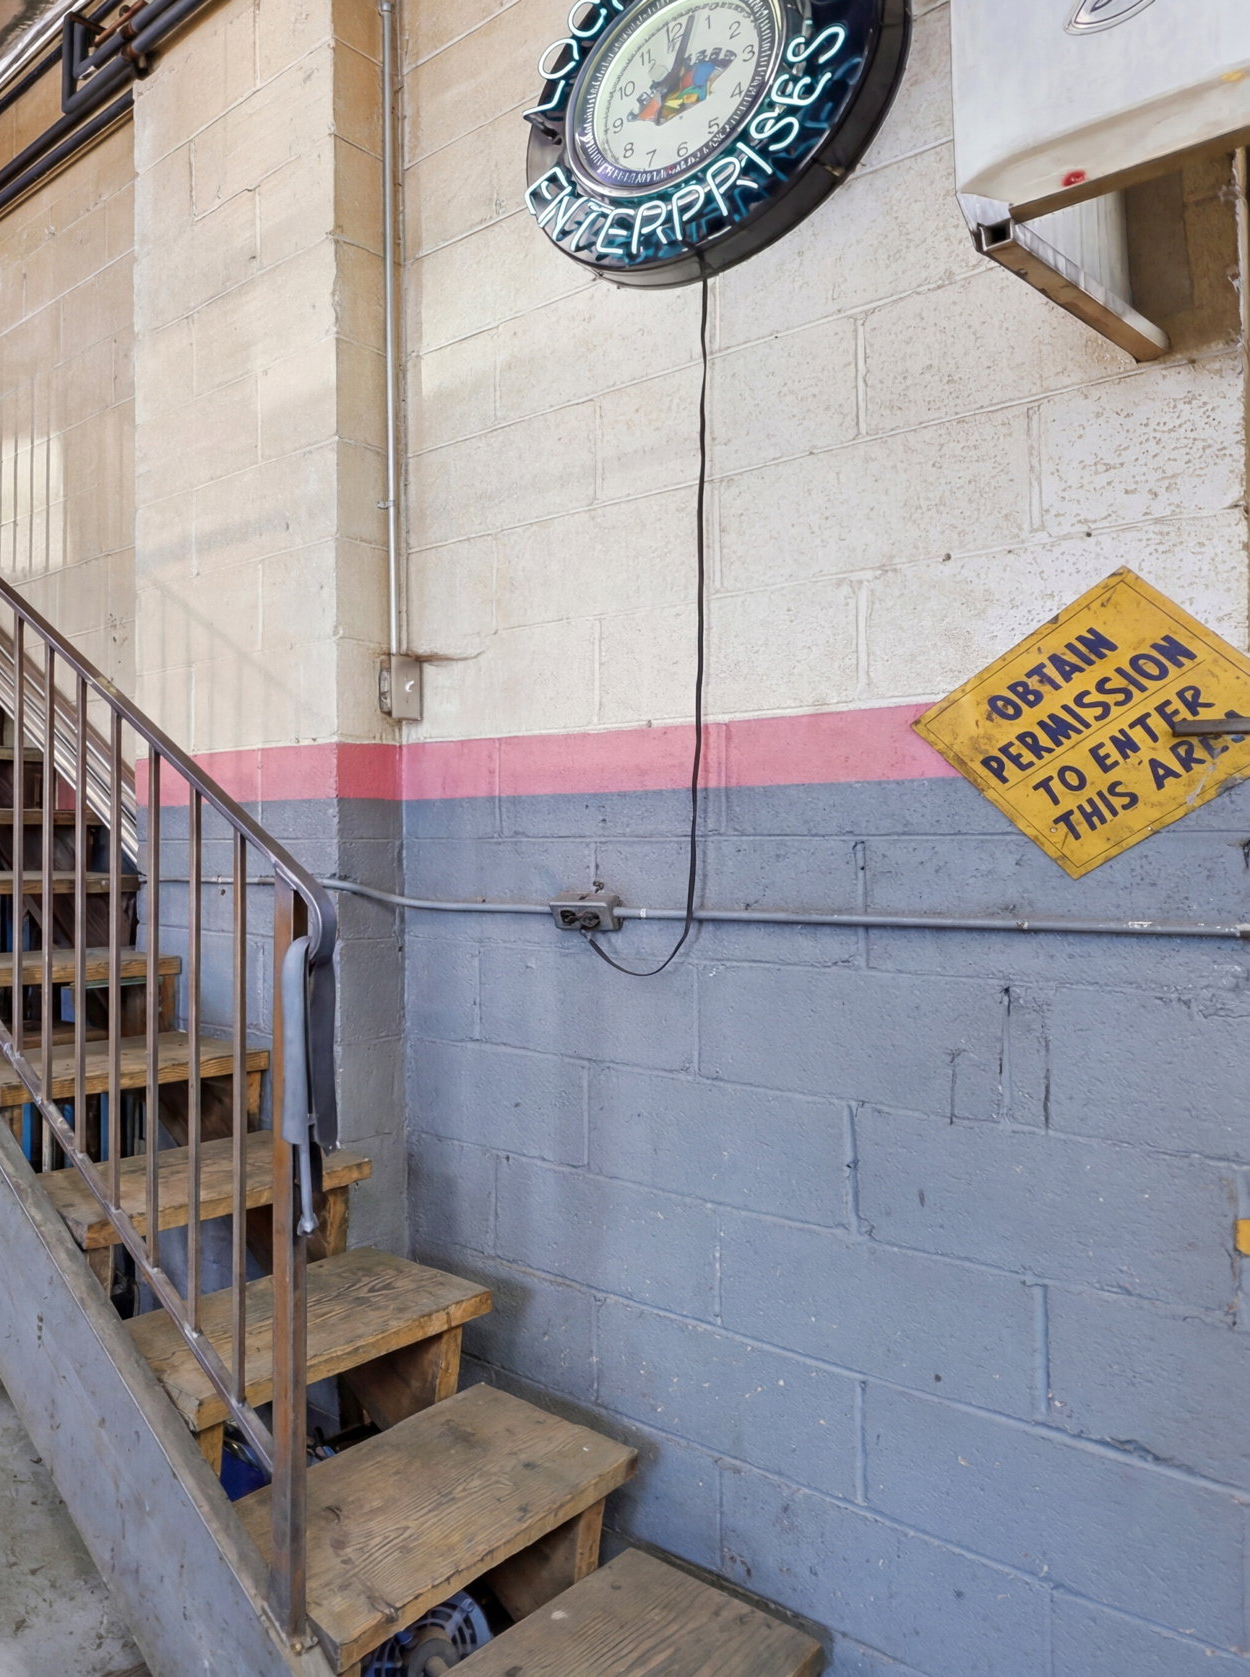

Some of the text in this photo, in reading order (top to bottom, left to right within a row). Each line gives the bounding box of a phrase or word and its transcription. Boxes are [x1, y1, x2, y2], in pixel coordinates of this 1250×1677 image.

[705, 15, 712, 30] 1
[728, 20, 742, 40] 2
[664, 22, 684, 46] 12
[522, 0, 624, 119] LOC
[638, 49, 653, 67] 11
[742, 44, 756, 63] 3
[617, 80, 636, 100] 10
[730, 81, 744, 99] 4
[612, 117, 624, 134] 9
[707, 117, 721, 135] 5
[525, 25, 845, 254] ENTERPRISES
[623, 142, 635, 159] 8
[645, 149, 657, 167] 7
[676, 141, 689, 158] 6
[987, 627, 1119, 722] OBTAIN
[980, 634, 1198, 784] PERMISSION
[1031, 684, 1216, 807] TO ENTER
[1052, 779, 1139, 842] THIS
